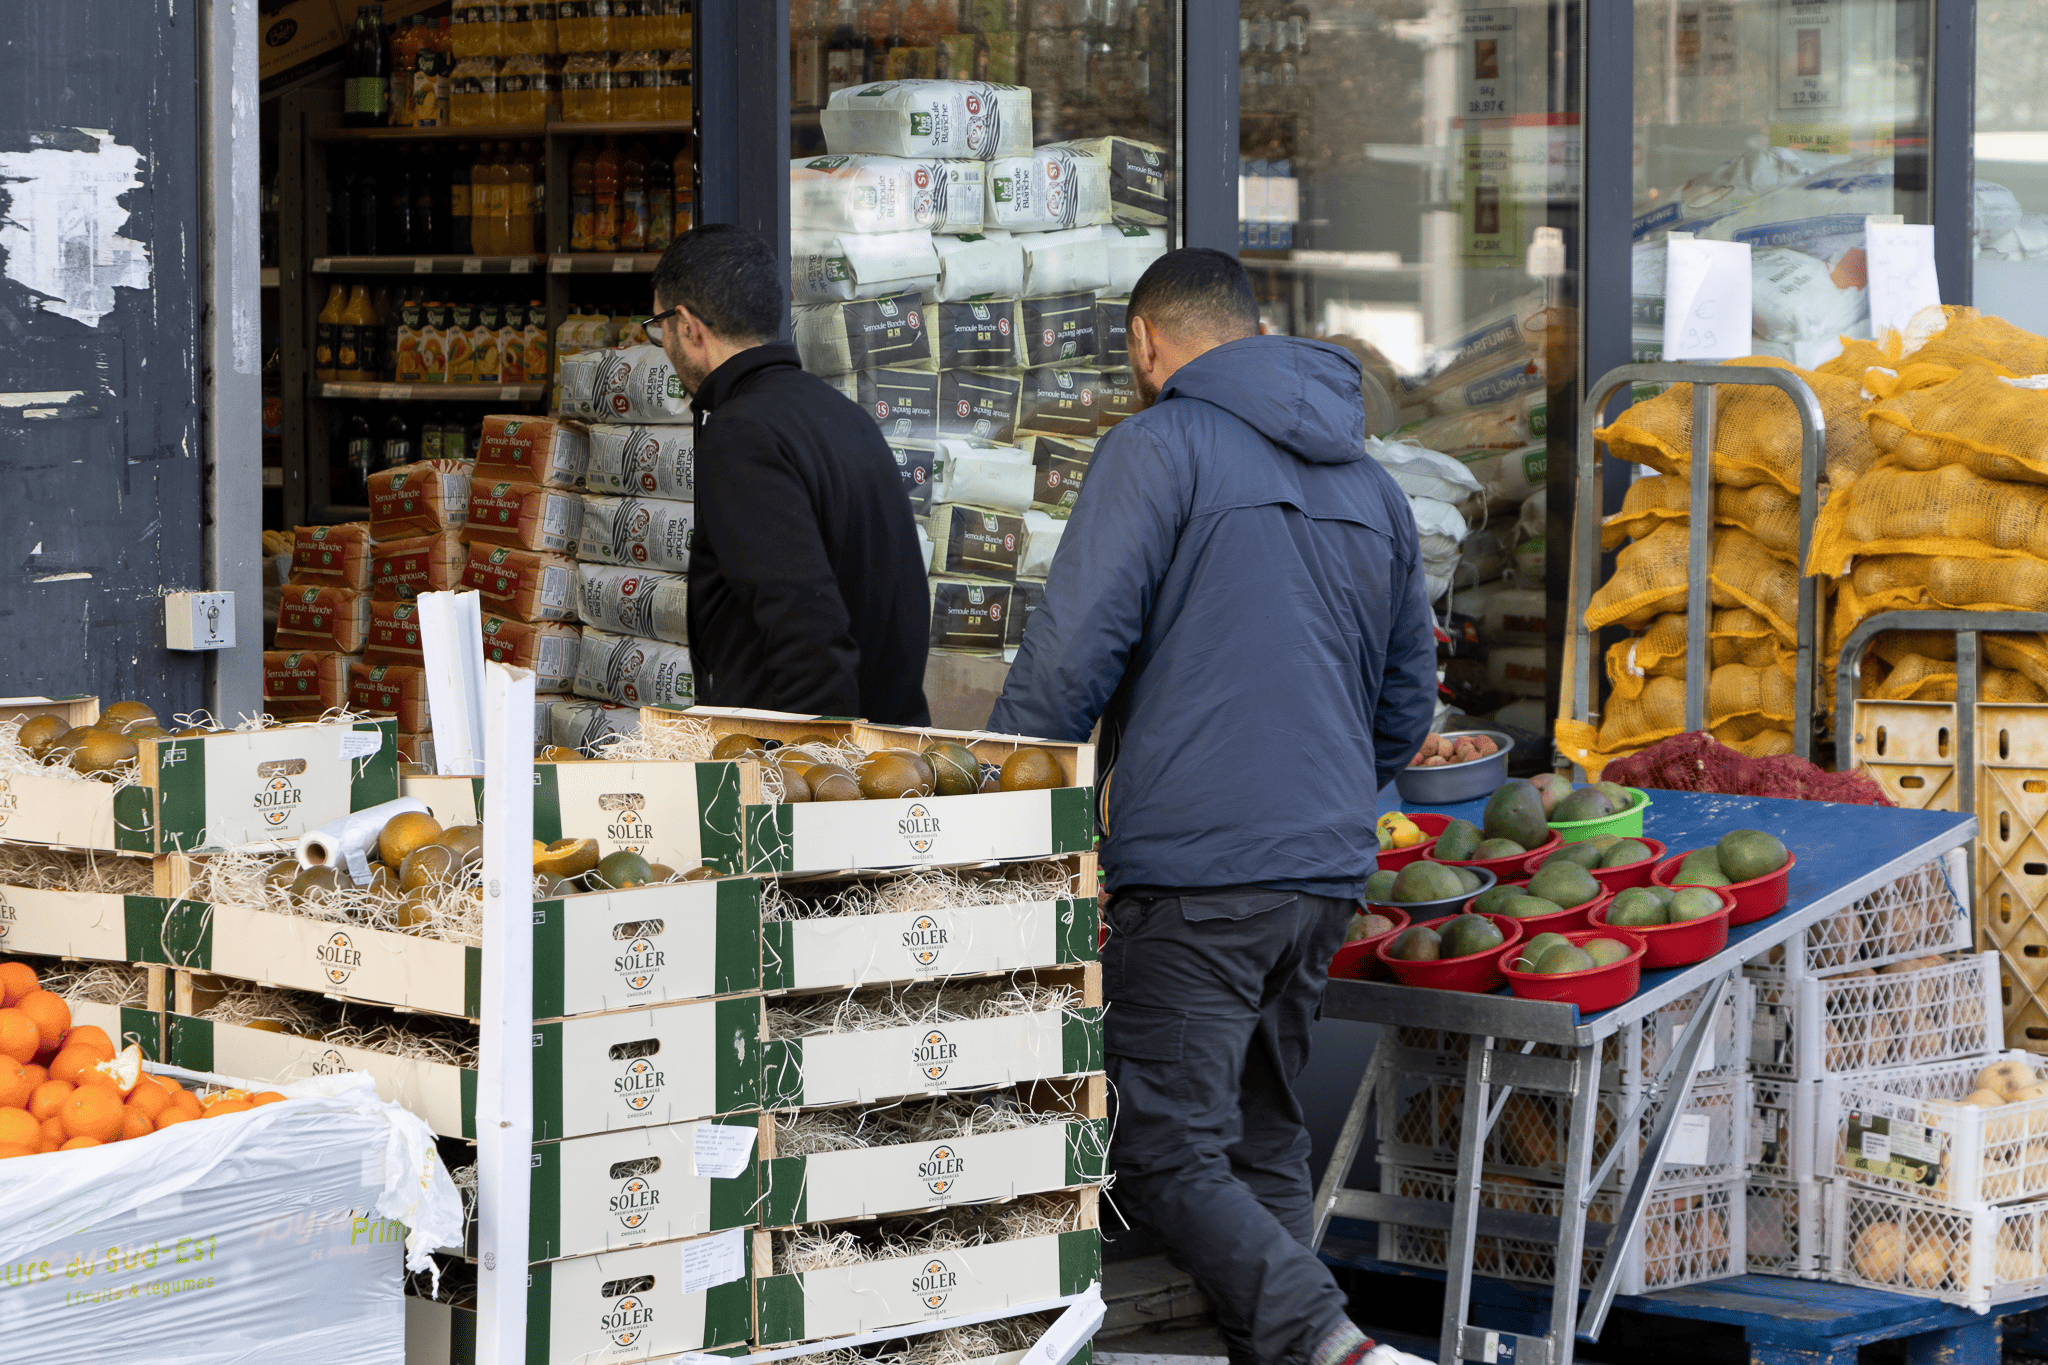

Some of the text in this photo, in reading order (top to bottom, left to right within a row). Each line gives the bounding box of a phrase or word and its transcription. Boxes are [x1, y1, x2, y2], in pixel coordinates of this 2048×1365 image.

[969, 98, 980, 112] S1
[932, 102, 940, 146] Semoule
[1788, 135, 1831, 145] TILDA RIZ
[917, 172, 927, 186] S1
[1050, 164, 1058, 178] S1
[878, 175, 886, 220] Semoule
[909, 314, 919, 326] S1
[1000, 320, 1009, 333] S1
[1460, 326, 1516, 358] PARFUME
[647, 367, 658, 405] Blanche
[656, 364, 668, 408] Semoule
[1470, 373, 1527, 402] RIZ LONG
[616, 397, 626, 410] S1
[1083, 392, 1091, 402] S1
[877, 404, 887, 416] S1
[958, 403, 968, 414] S1
[676, 448, 686, 488] Blanche
[916, 468, 924, 482] S1
[644, 477, 654, 490] S1
[666, 520, 677, 558] Blanche
[676, 518, 688, 562] Semoule
[635, 548, 644, 560] S1
[624, 580, 636, 592] S1
[594, 580, 604, 618] Blanche
[992, 607, 1000, 616] S1
[374, 618, 400, 629] Semoule
[488, 636, 514, 650] Blanche
[656, 662, 668, 700] Blanche
[664, 661, 676, 704] Semoule
[626, 687, 638, 698] S1
[253, 788, 302, 808] SOLER
[608, 824, 654, 839] SOLER
[898, 818, 942, 834] SOLER
[902, 928, 948, 947] SOLER
[316, 944, 362, 966] SOLER
[614, 951, 666, 972] SOLER
[912, 1043, 958, 1062] SOLER
[614, 1071, 666, 1094] SOLER
[918, 1158, 964, 1178] SOLER
[609, 1189, 660, 1212] SOLER
[0, 1233, 218, 1287] urs du Sud-Est
[128, 1284, 140, 1299] &
[146, 1276, 214, 1299] légumes
[912, 1272, 958, 1293] SOLER
[600, 1308, 654, 1330] SOLER
